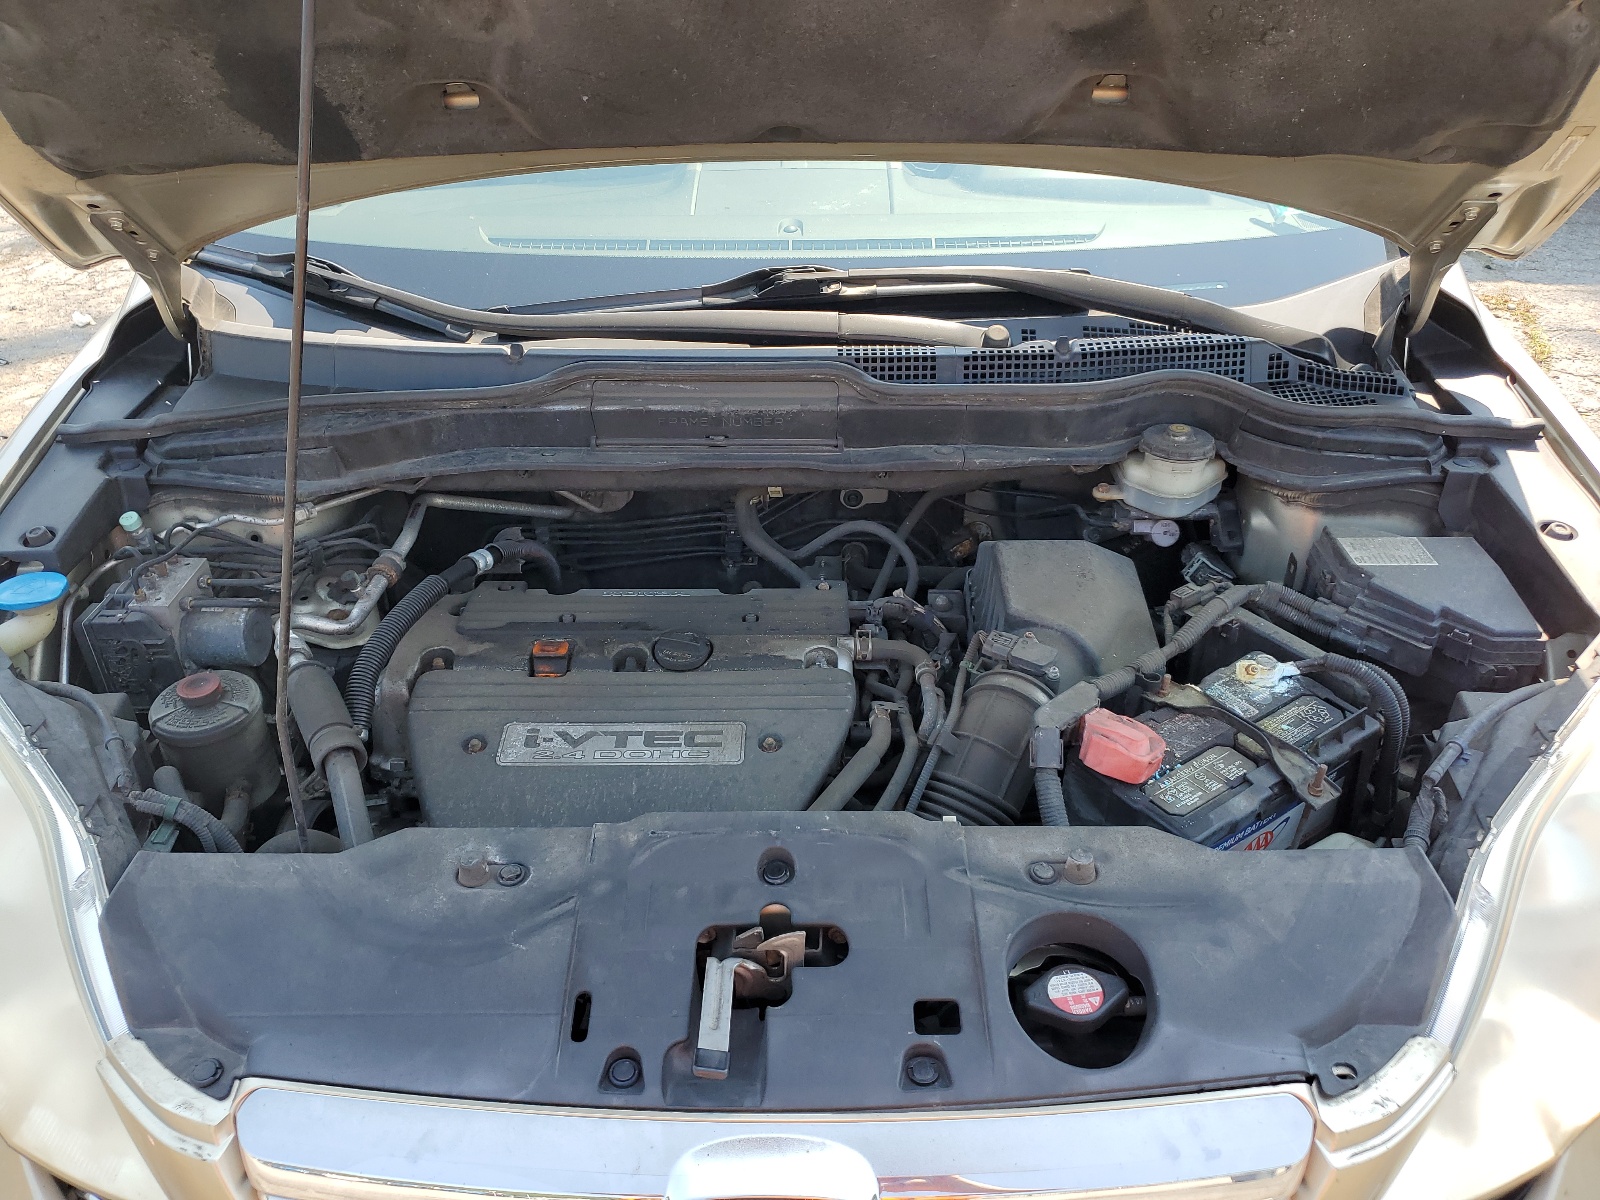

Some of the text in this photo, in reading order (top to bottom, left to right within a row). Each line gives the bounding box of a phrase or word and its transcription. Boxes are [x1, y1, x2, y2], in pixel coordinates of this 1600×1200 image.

[658, 417, 784, 427] FRAME NUMBER
[523, 728, 724, 749] i-VTEC
[532, 749, 711, 760] 2.4 DOHC
